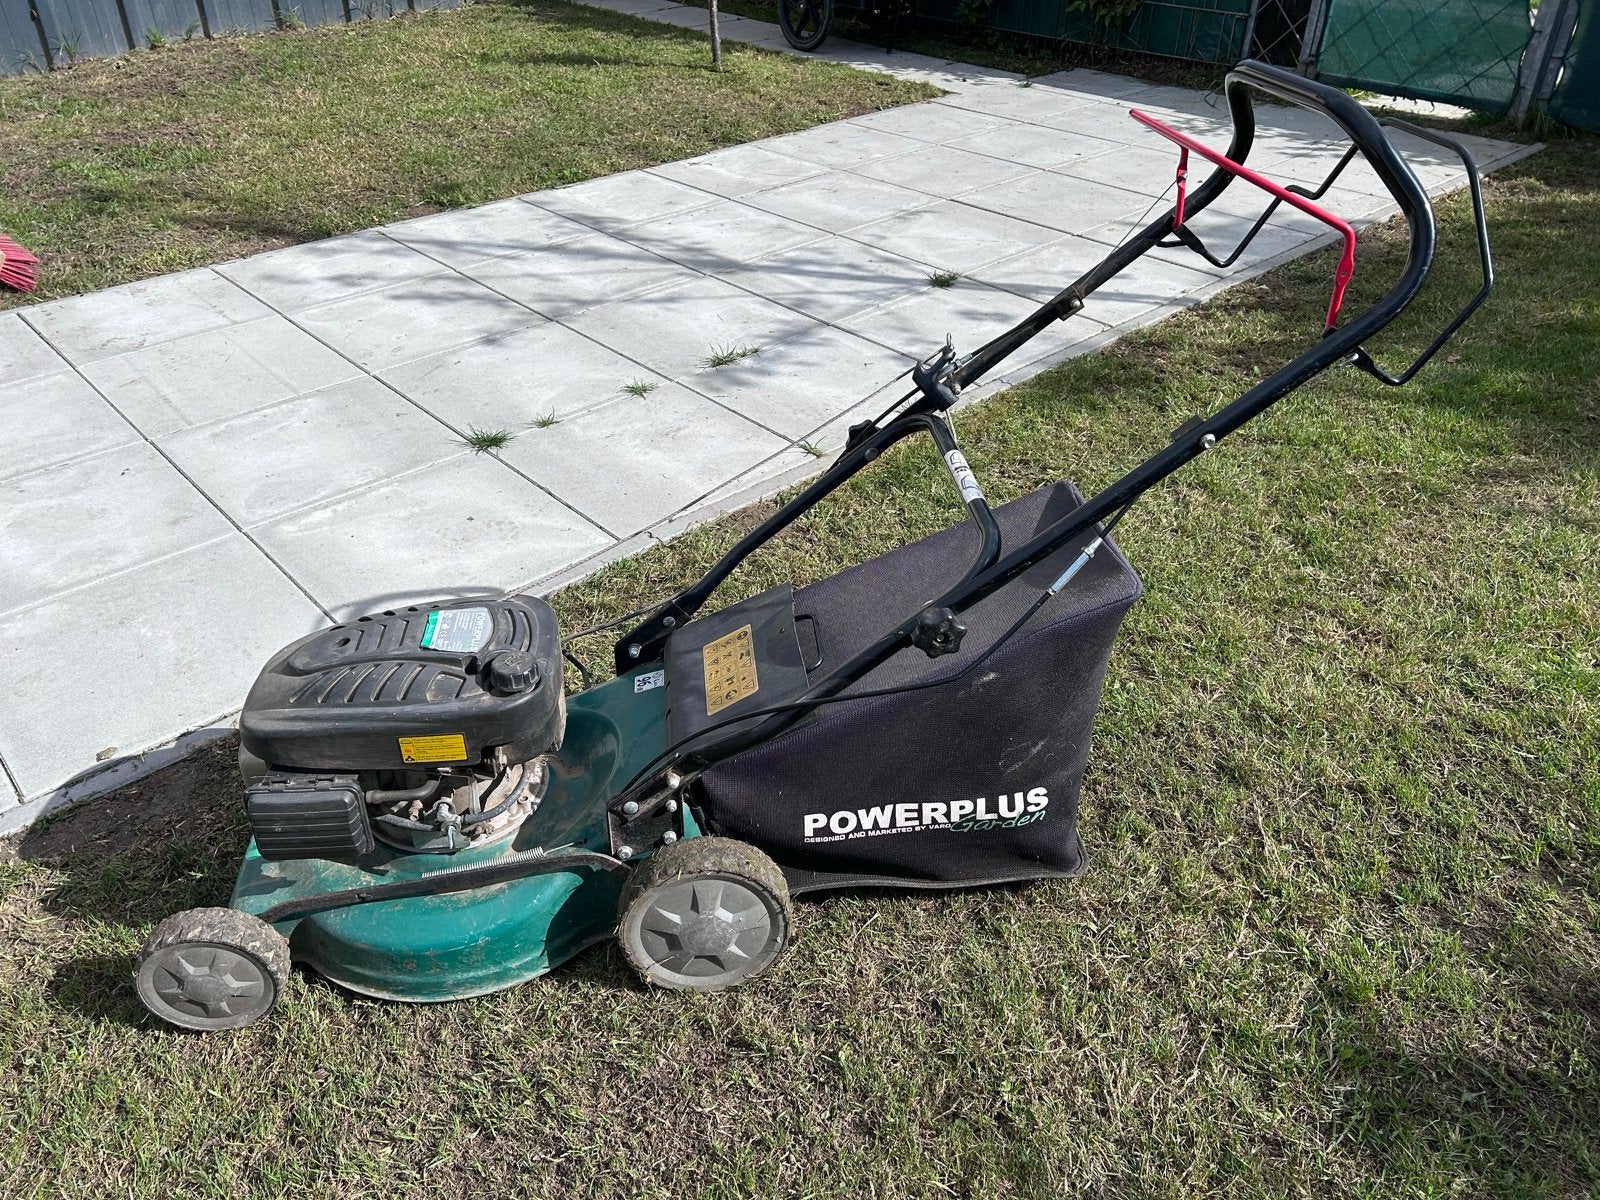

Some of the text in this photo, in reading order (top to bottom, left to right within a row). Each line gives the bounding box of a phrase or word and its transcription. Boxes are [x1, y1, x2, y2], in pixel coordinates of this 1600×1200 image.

[470, 611, 486, 651] POWERPLUS
[804, 787, 1049, 837] POWERPLUS
[950, 810, 1046, 832] Garden
[804, 834, 846, 843] DESIGNED
[848, 831, 866, 840] AND
[868, 827, 913, 837] MARKETED
